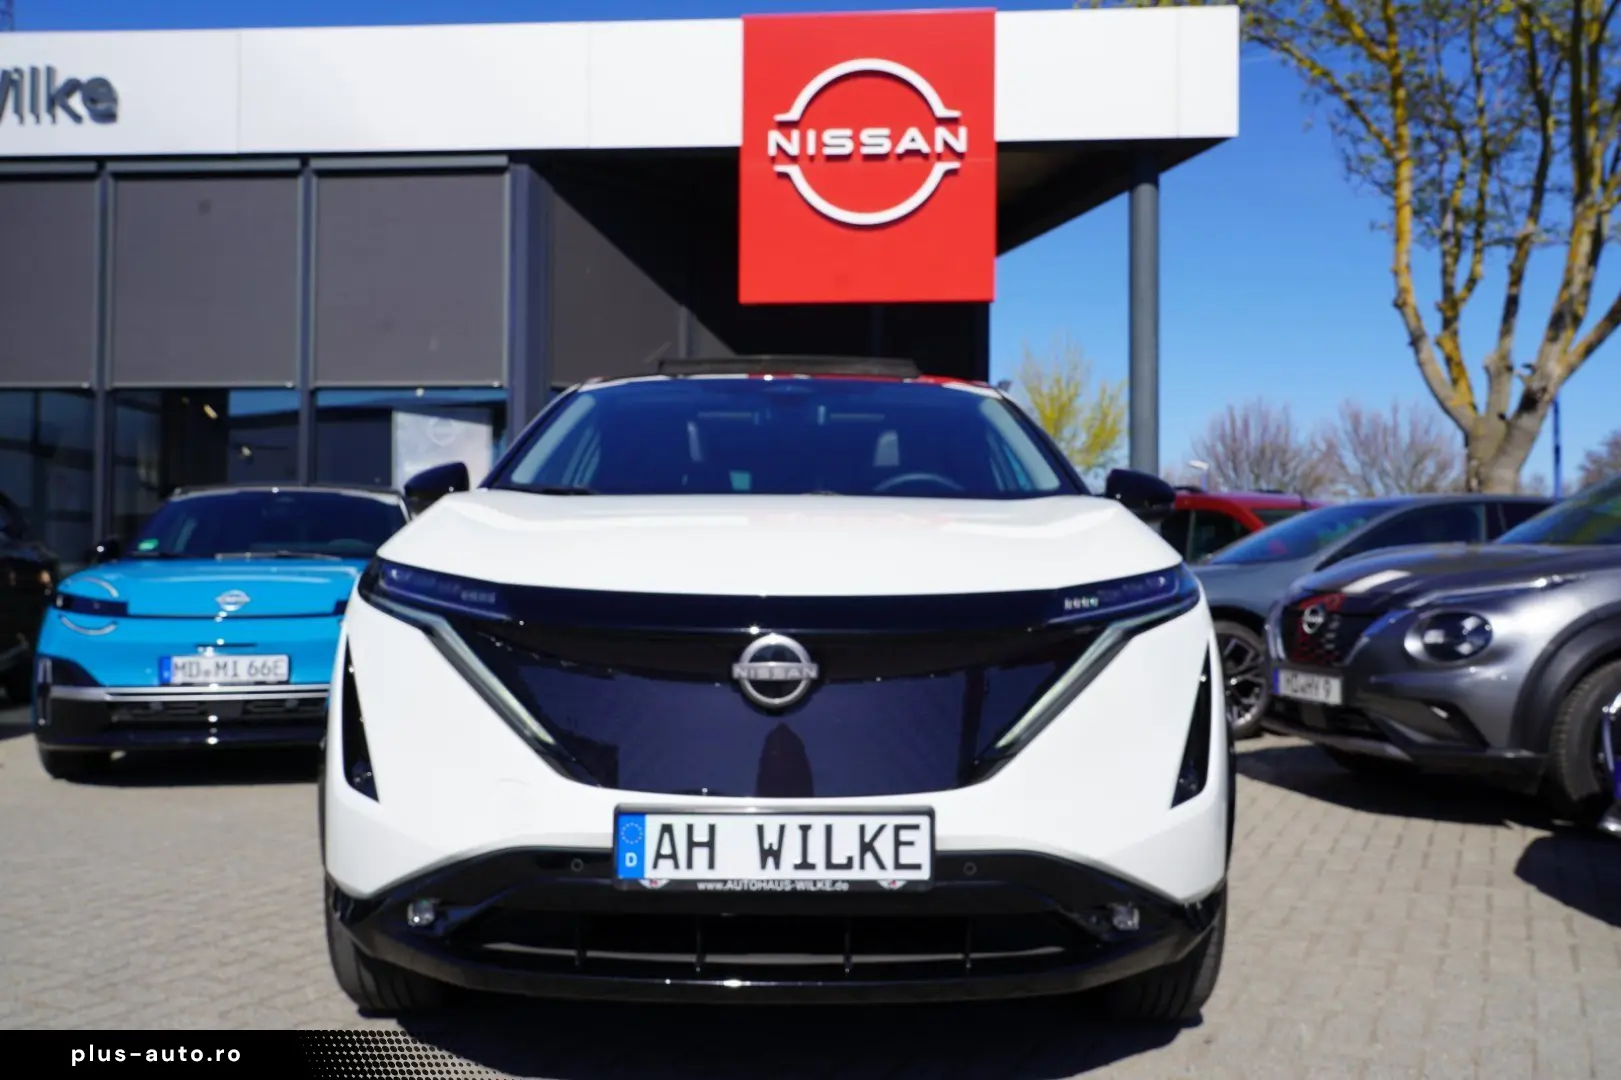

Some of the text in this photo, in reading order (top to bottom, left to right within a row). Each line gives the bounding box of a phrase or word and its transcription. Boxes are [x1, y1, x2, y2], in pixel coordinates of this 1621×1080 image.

[767, 126, 968, 157] NISSAN
[624, 852, 638, 868] D
[652, 823, 922, 871] AH WILKE
